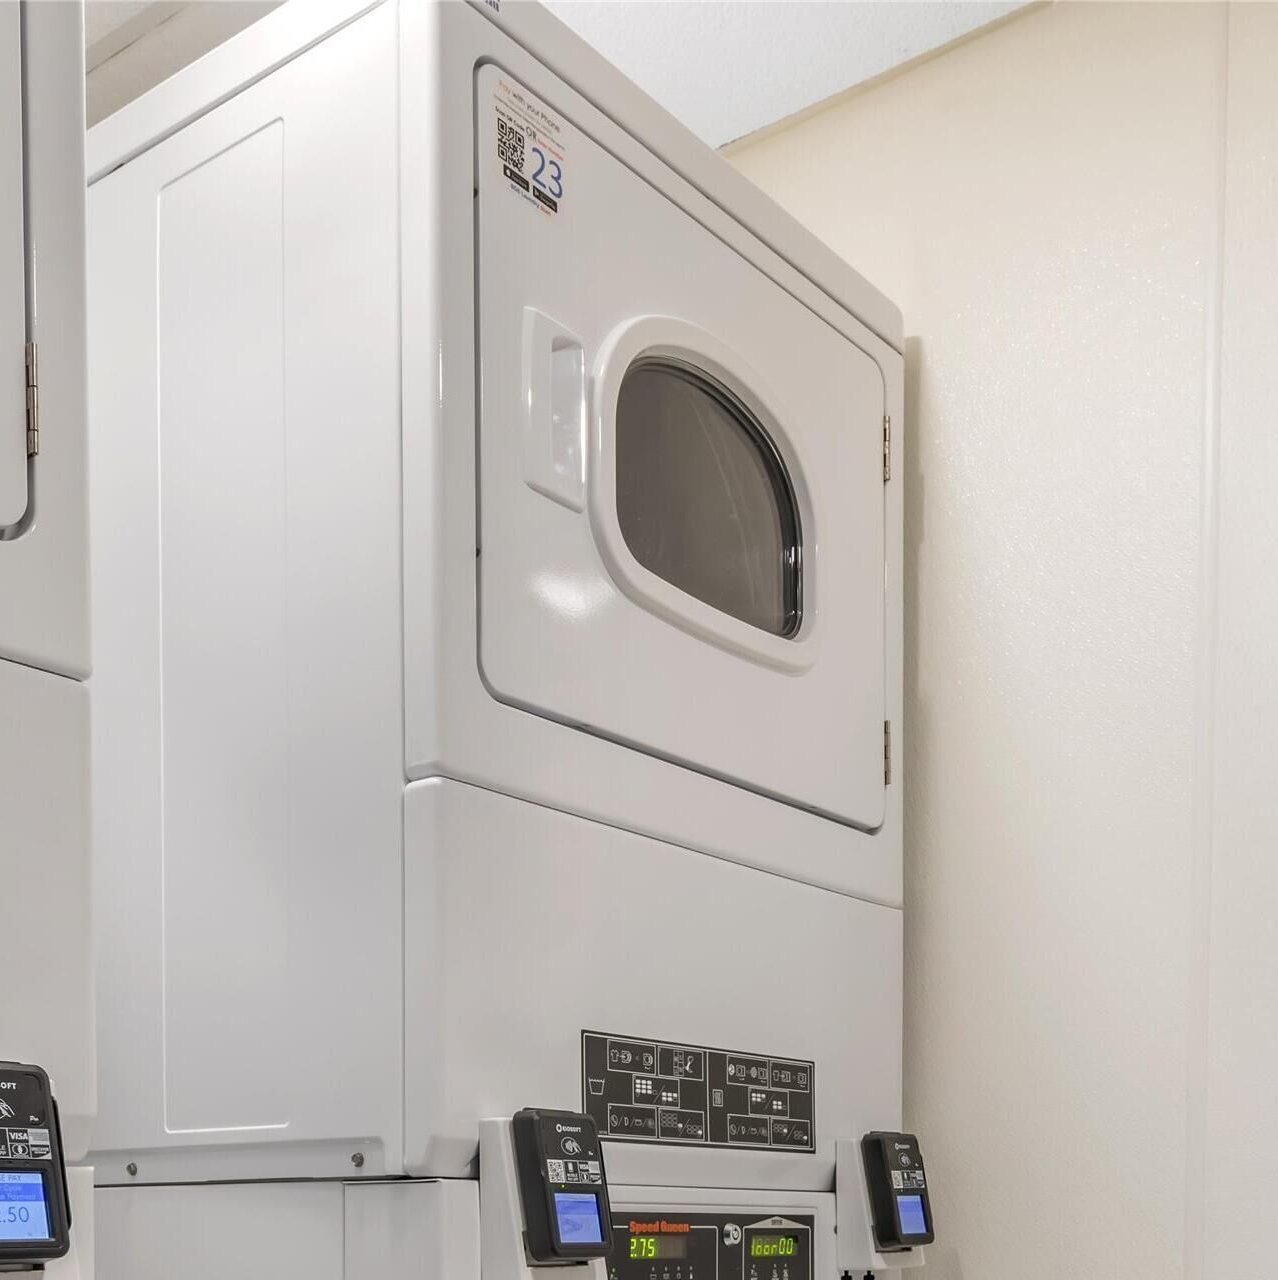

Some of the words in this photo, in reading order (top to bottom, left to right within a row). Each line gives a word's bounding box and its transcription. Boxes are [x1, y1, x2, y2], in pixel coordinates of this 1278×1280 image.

[532, 147, 563, 199] 23
[9, 1132, 29, 1140] VISA
[629, 1221, 660, 1234] Speed
[660, 1219, 690, 1233] Queen
